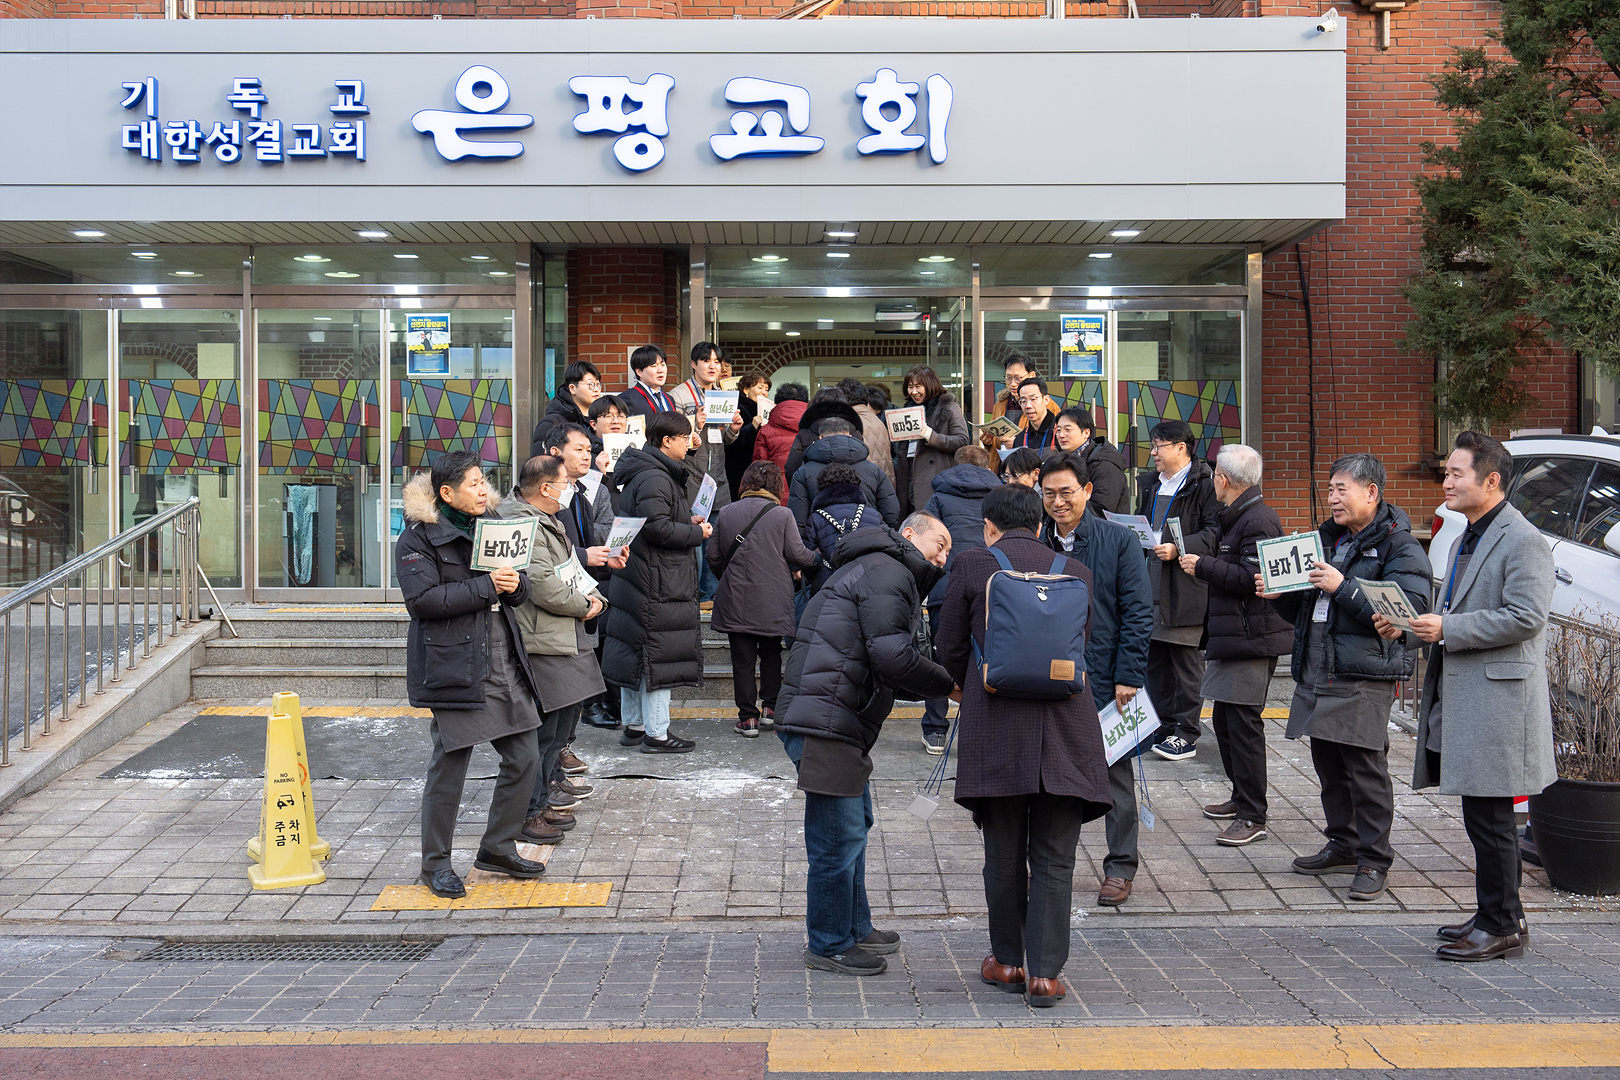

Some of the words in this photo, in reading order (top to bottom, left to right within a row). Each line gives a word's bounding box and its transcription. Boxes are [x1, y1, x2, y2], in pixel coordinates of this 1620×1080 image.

[411, 64, 953, 173] 은평교회
[121, 119, 367, 164] 대한성결교회
[709, 400, 734, 414] 청년4조
[892, 415, 920, 433] 여자5조
[483, 529, 528, 559] 남자3조
[1268, 545, 1316, 577] 남자1조
[1104, 705, 1148, 748] 남자5조
[274, 819, 300, 833] 주차
[275, 833, 300, 847] 금지
